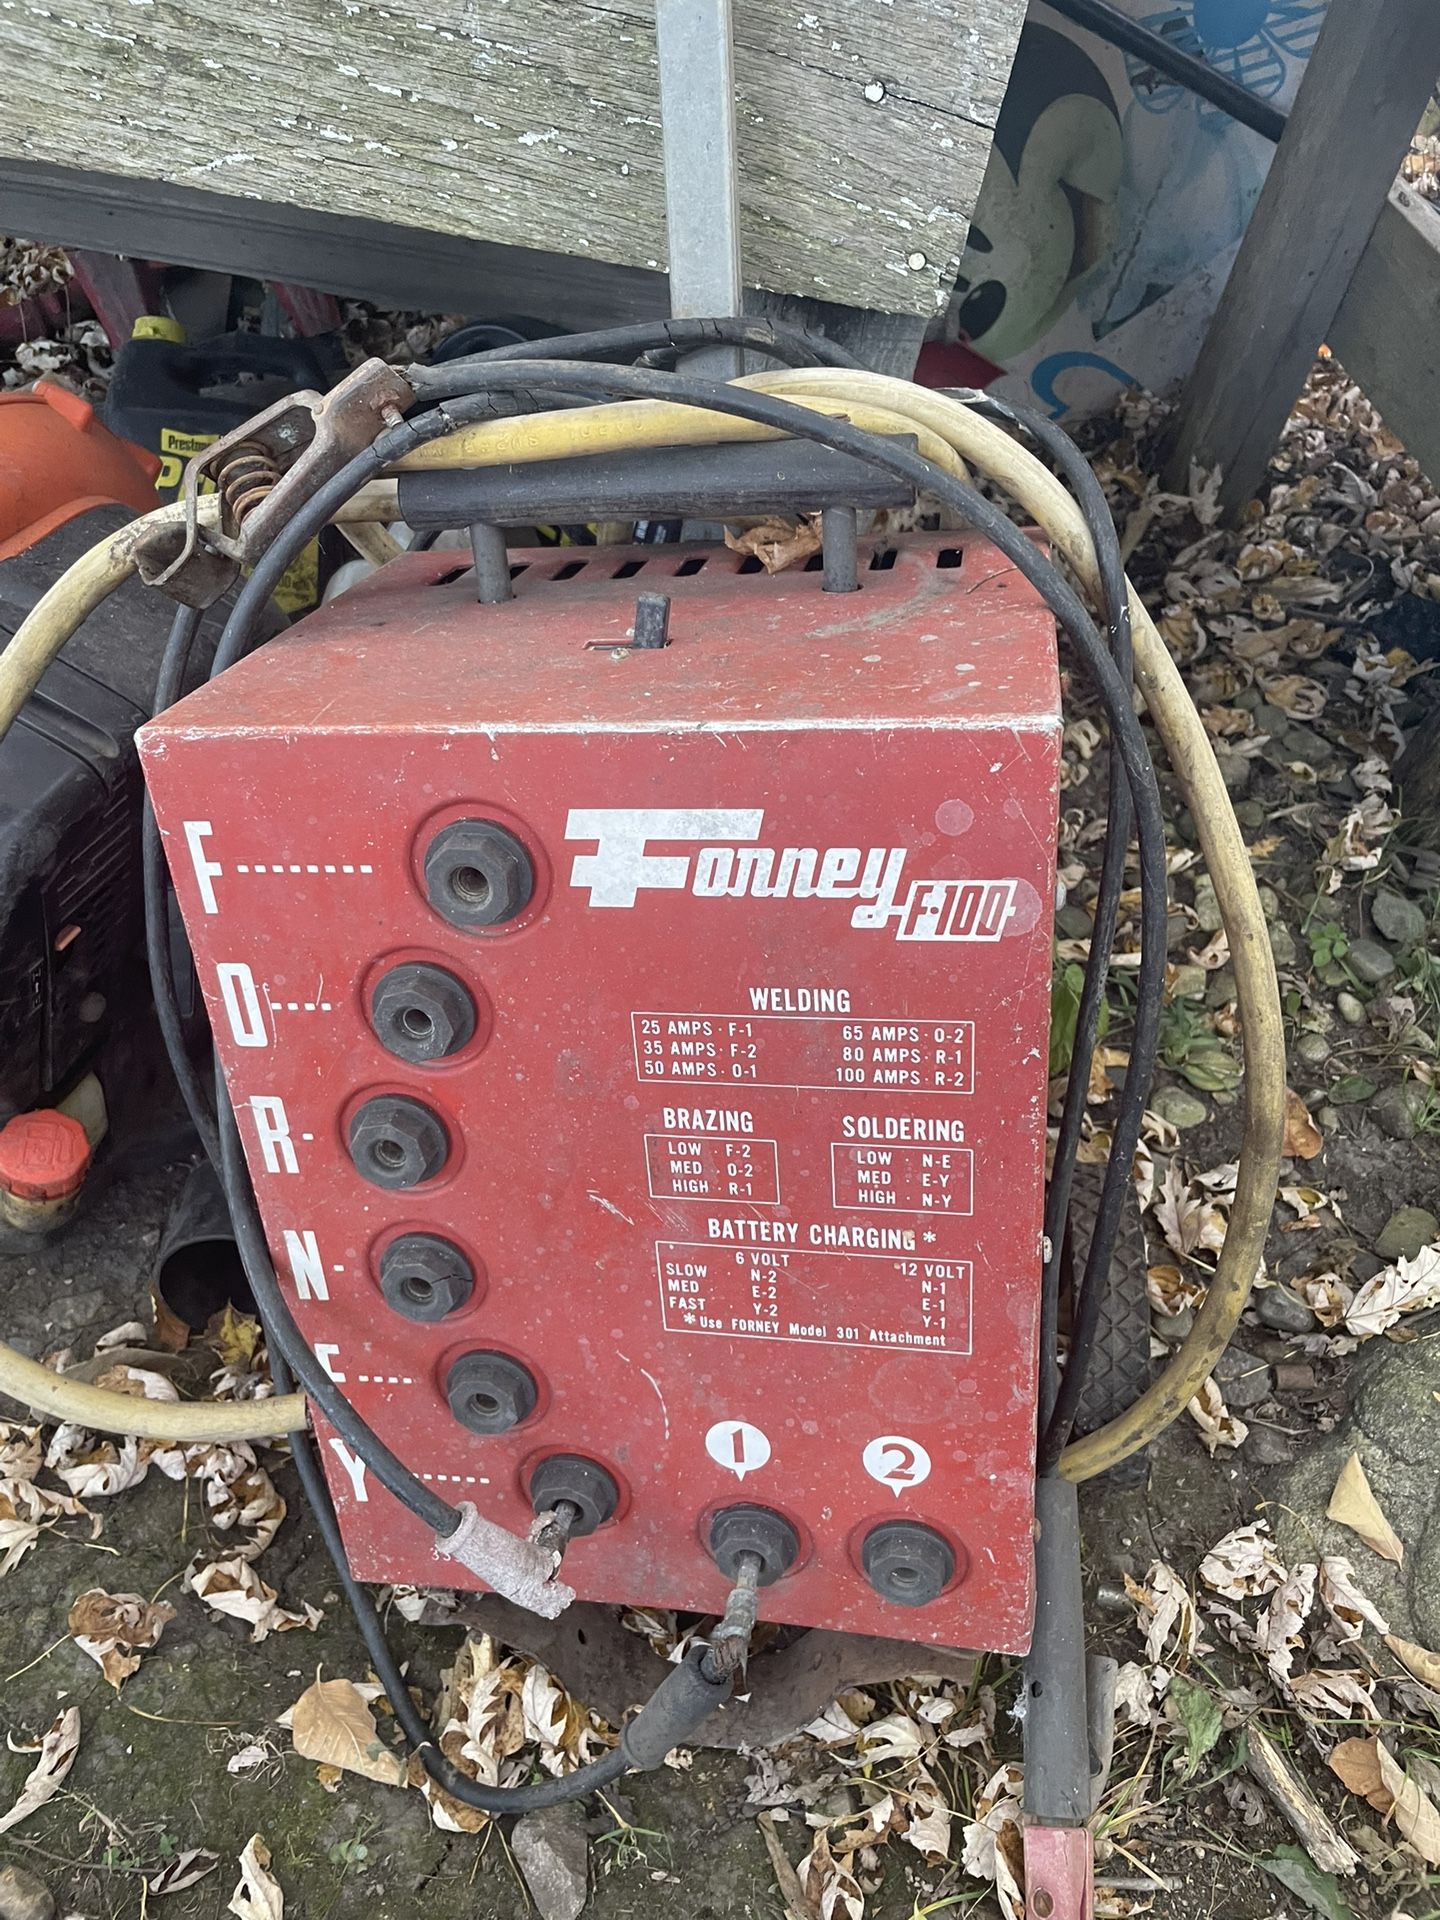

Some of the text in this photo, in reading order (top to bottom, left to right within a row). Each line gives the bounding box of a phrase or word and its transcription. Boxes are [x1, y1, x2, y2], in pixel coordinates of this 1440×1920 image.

[183, 820, 223, 914] F
[565, 809, 907, 928] Forney
[749, 987, 851, 1013] WELDING
[641, 1020, 753, 1037] 25 AMPS F-1
[842, 1025, 864, 1041] 65
[871, 1026, 920, 1042] AMPS
[643, 1040, 757, 1058] 35 AMPS F-2
[842, 1047, 962, 1065] 80 AMPS R-1
[644, 1060, 665, 1075] 50
[671, 1061, 717, 1077] AMPS
[836, 1067, 965, 1087] 100 AMPS R-2
[663, 1107, 754, 1133] BRAZING
[842, 1115, 965, 1143] SOLDERING
[250, 1095, 300, 1174] R
[668, 1141, 751, 1158] LOW F-2
[857, 1150, 951, 1169] LOW N-E
[670, 1160, 703, 1174] MED
[672, 1179, 752, 1196] HIGH R-1
[857, 1169, 950, 1188] MED E-Y
[858, 1188, 952, 1208] HIGH N-Y
[707, 1217, 799, 1243] BATTERY
[283, 1230, 330, 1301] N
[735, 1251, 790, 1267] 6 VOLT
[665, 1262, 777, 1283] SLOW N-2
[900, 1262, 965, 1280] 12 VOLT
[667, 1279, 777, 1299] MED E-2
[921, 1280, 947, 1295] N-1
[668, 1296, 778, 1317] FAST Y-2
[921, 1297, 946, 1312] E-1
[731, 1318, 780, 1334] FORNEY
[789, 1322, 827, 1337] Model
[836, 1326, 859, 1340] 301
[869, 1329, 946, 1346] Attachment
[922, 1315, 947, 1330] Y-1
[732, 1428, 745, 1463] 1
[883, 1443, 916, 1481] 2
